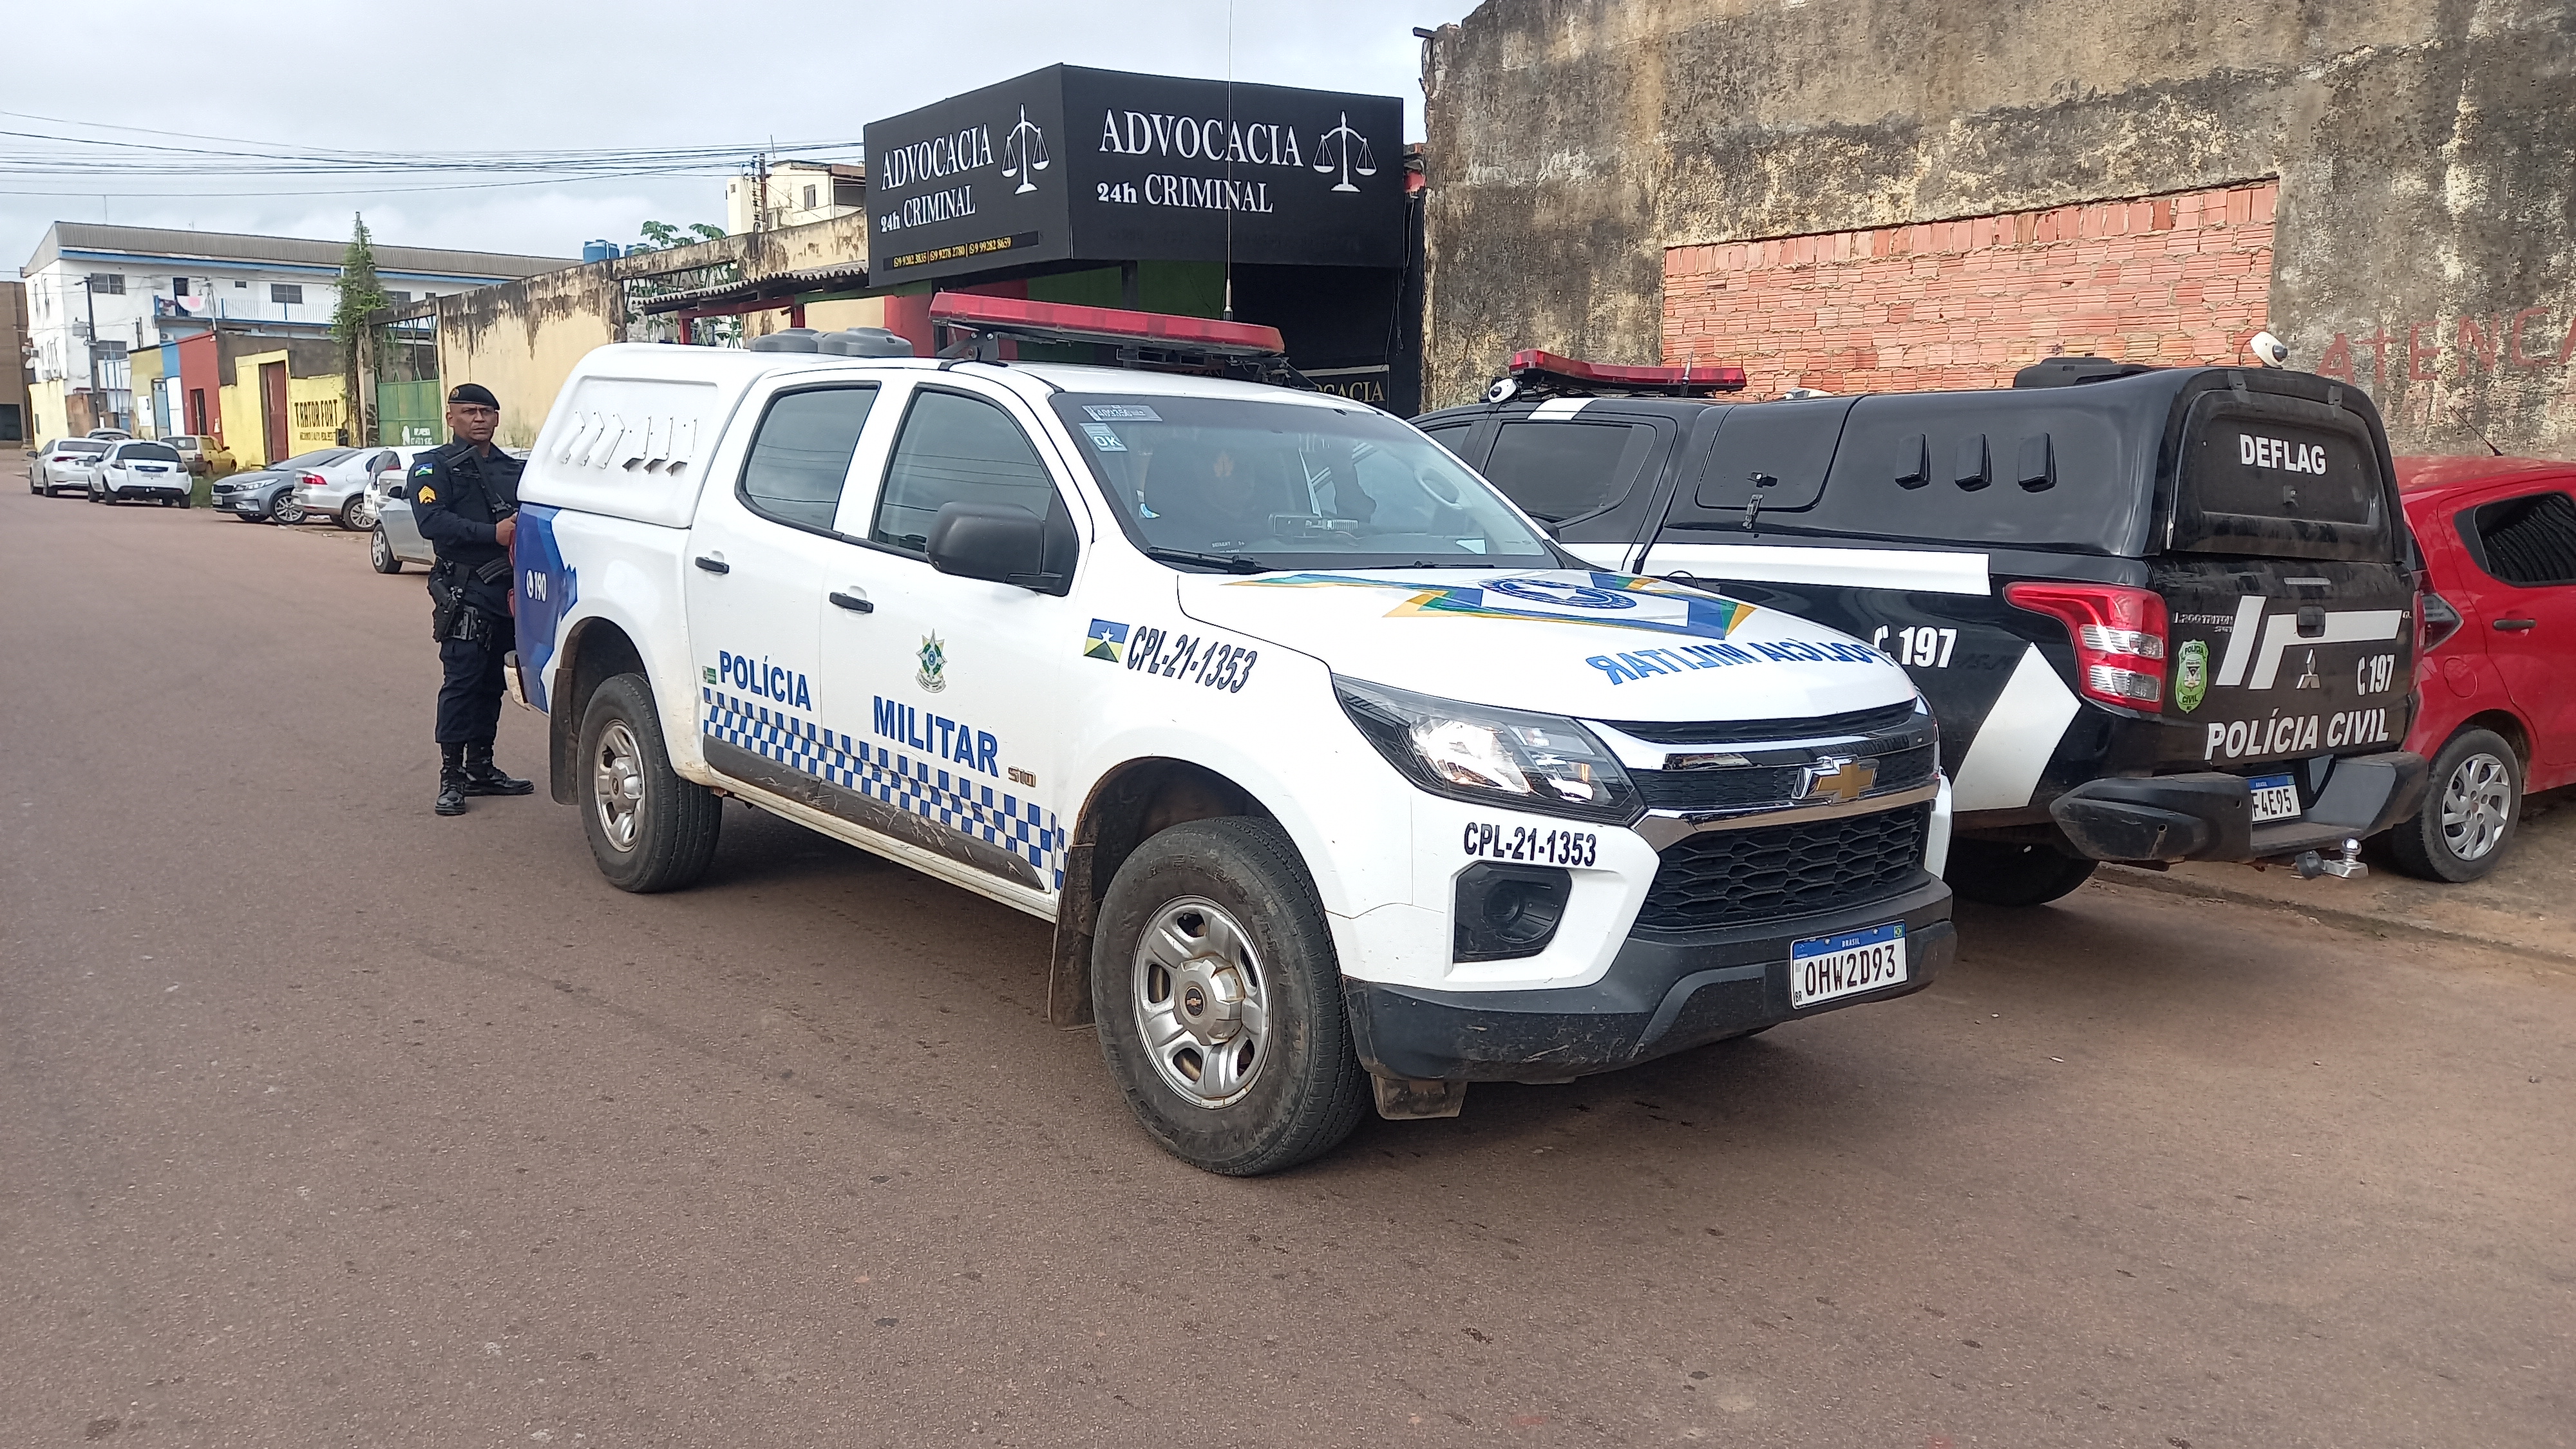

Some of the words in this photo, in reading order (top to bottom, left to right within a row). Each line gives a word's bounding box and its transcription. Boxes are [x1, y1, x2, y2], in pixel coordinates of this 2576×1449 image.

[881, 124, 994, 191] ADVOCACIA
[1099, 108, 1304, 167] ADVOCACIA
[880, 211, 901, 232] 24h
[904, 185, 976, 228] CRIMINAL
[1097, 182, 1137, 204] 24h
[1145, 173, 1274, 213] CRIMINAL
[321, 399, 338, 427] FORT
[1094, 436, 1122, 447] OK
[2239, 433, 2326, 475] DEFLAG
[534, 571, 547, 602] 190
[1128, 627, 1258, 694] CPL-21-1353
[1899, 626, 1958, 668] 197
[719, 650, 812, 712] POLÍCIA
[2369, 654, 2395, 694] 197
[874, 696, 999, 777] MILITAR
[2204, 708, 2319, 761] POLÍCIA
[2327, 708, 2389, 747] CIVIL
[1464, 822, 1596, 867] CPL-21-1353
[1841, 937, 1861, 948] BRASIL
[1805, 944, 1895, 996] OHW2D93
[1795, 990, 1803, 1003] BR
